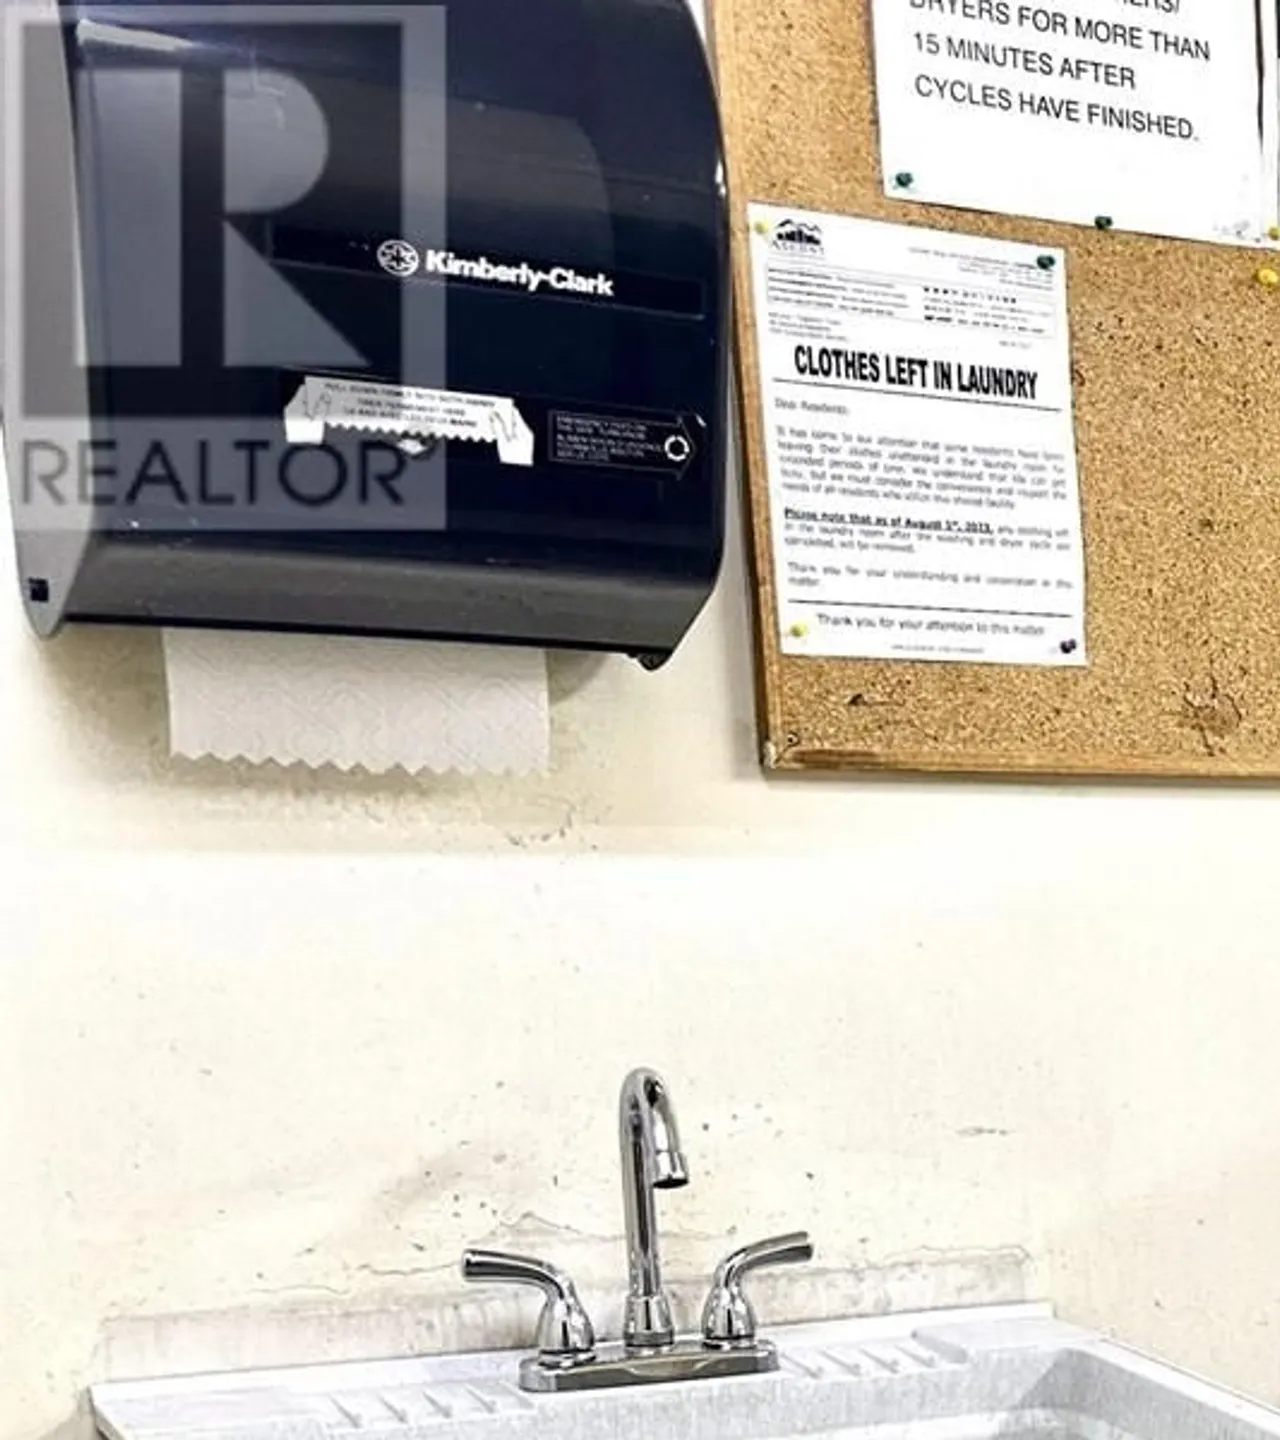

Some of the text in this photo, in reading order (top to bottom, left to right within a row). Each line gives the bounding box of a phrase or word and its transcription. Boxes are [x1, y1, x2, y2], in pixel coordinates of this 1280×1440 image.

[914, 32, 1136, 89] 15 MINUTES AFTER
[1018, 7, 1068, 35] FOR
[1075, 17, 1143, 49] MORE
[1149, 30, 1211, 61] THAN
[915, 74, 1199, 141] CYCLES HAVE FINISHED.
[426, 249, 614, 296] Kimberly-Clark
[794, 343, 1039, 400] CLOTHES LEFT IN LAUNDRY
